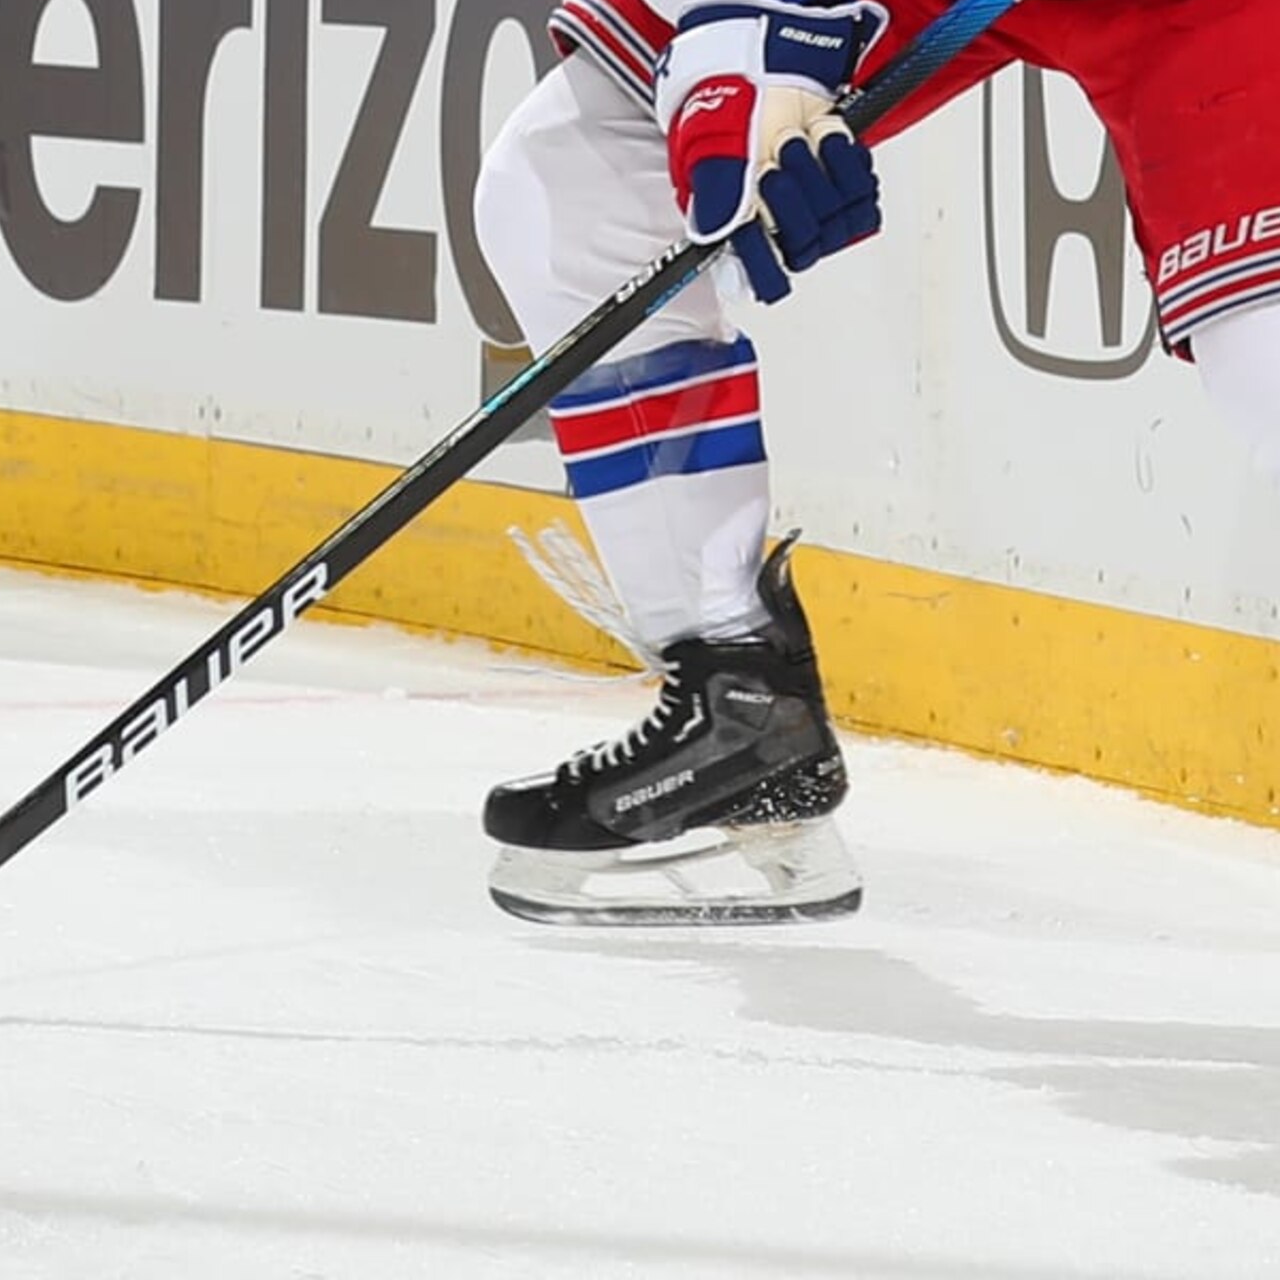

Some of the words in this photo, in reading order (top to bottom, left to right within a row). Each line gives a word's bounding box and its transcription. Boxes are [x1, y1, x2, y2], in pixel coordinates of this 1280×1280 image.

[779, 26, 844, 50] BAUER
[65, 562, 328, 811] BAUER
[615, 769, 695, 813] BAUER
